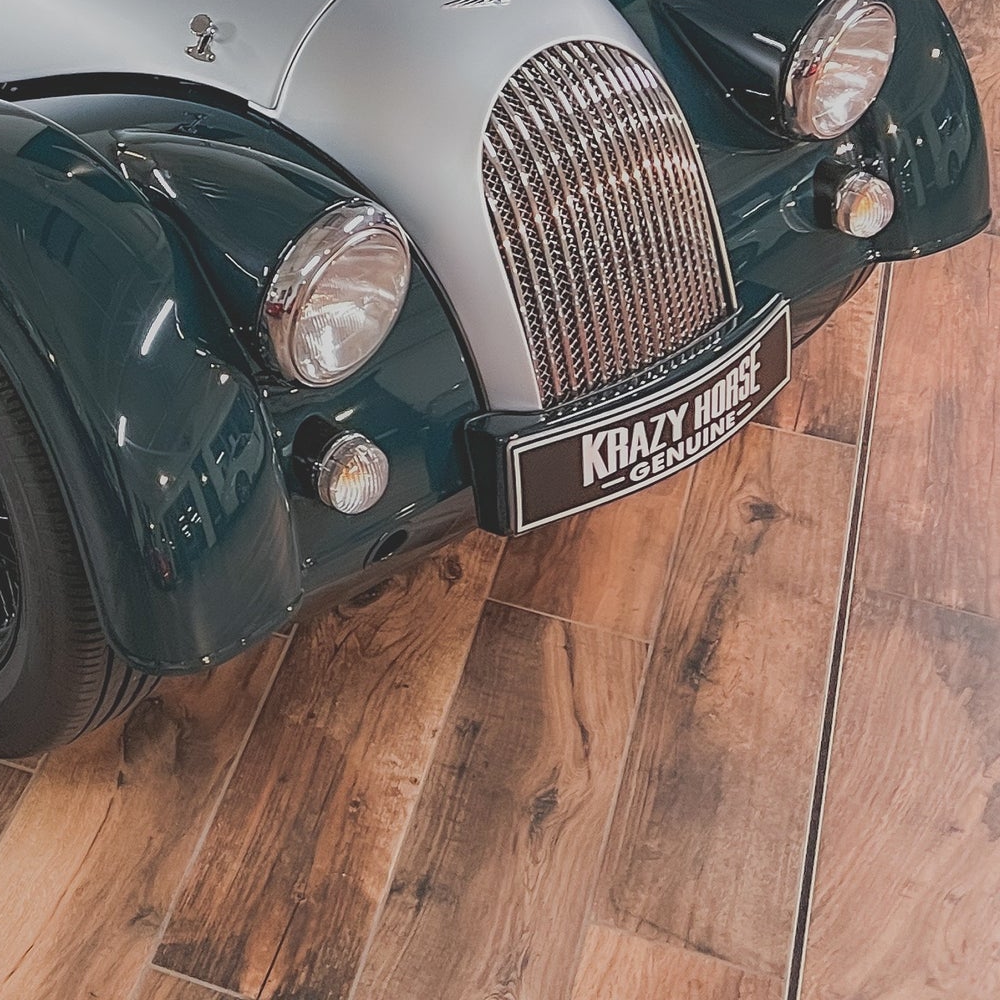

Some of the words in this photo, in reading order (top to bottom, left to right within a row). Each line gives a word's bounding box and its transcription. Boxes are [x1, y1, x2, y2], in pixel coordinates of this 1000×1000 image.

[582, 402, 689, 487] KRAZY
[694, 342, 761, 430] HORSE
[629, 411, 737, 482] GENUINE
